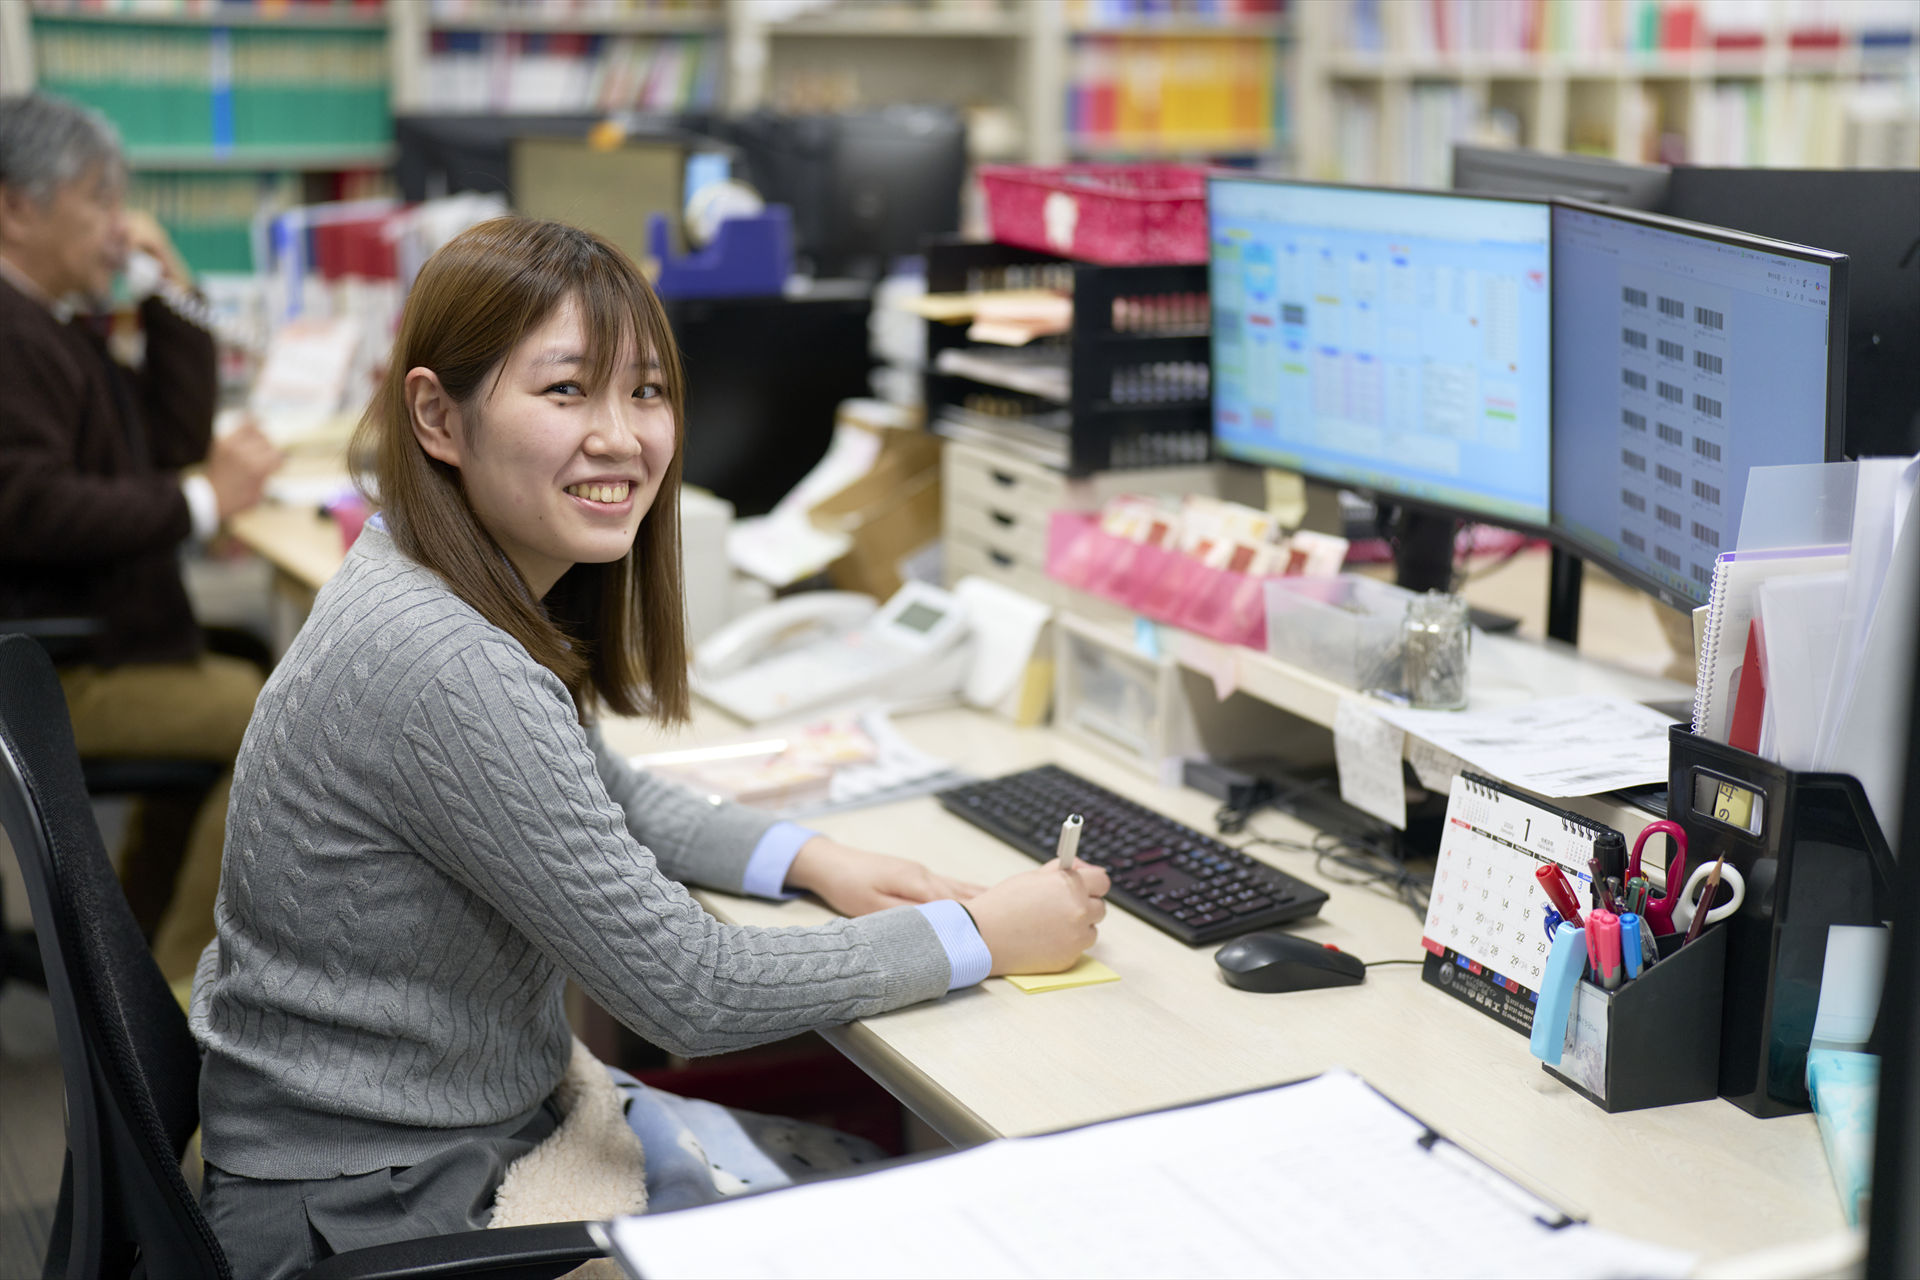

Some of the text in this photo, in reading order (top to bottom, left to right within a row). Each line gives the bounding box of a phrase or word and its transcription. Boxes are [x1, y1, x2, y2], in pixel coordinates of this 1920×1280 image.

[1525, 818, 1531, 842] 1
[1507, 875, 1514, 885] 7
[1529, 885, 1535, 895] 8
[1577, 880, 1583, 890] 3
[1502, 898, 1509, 909] 14
[1523, 908, 1530, 919] 15
[1475, 911, 1484, 922] 20
[1496, 921, 1504, 932] 21
[1516, 931, 1526, 943] 22
[1537, 941, 1546, 953] 23
[1470, 935, 1479, 945] 27
[1490, 944, 1499, 956] 28
[1510, 954, 1519, 966] 29
[1531, 965, 1540, 977] 30
